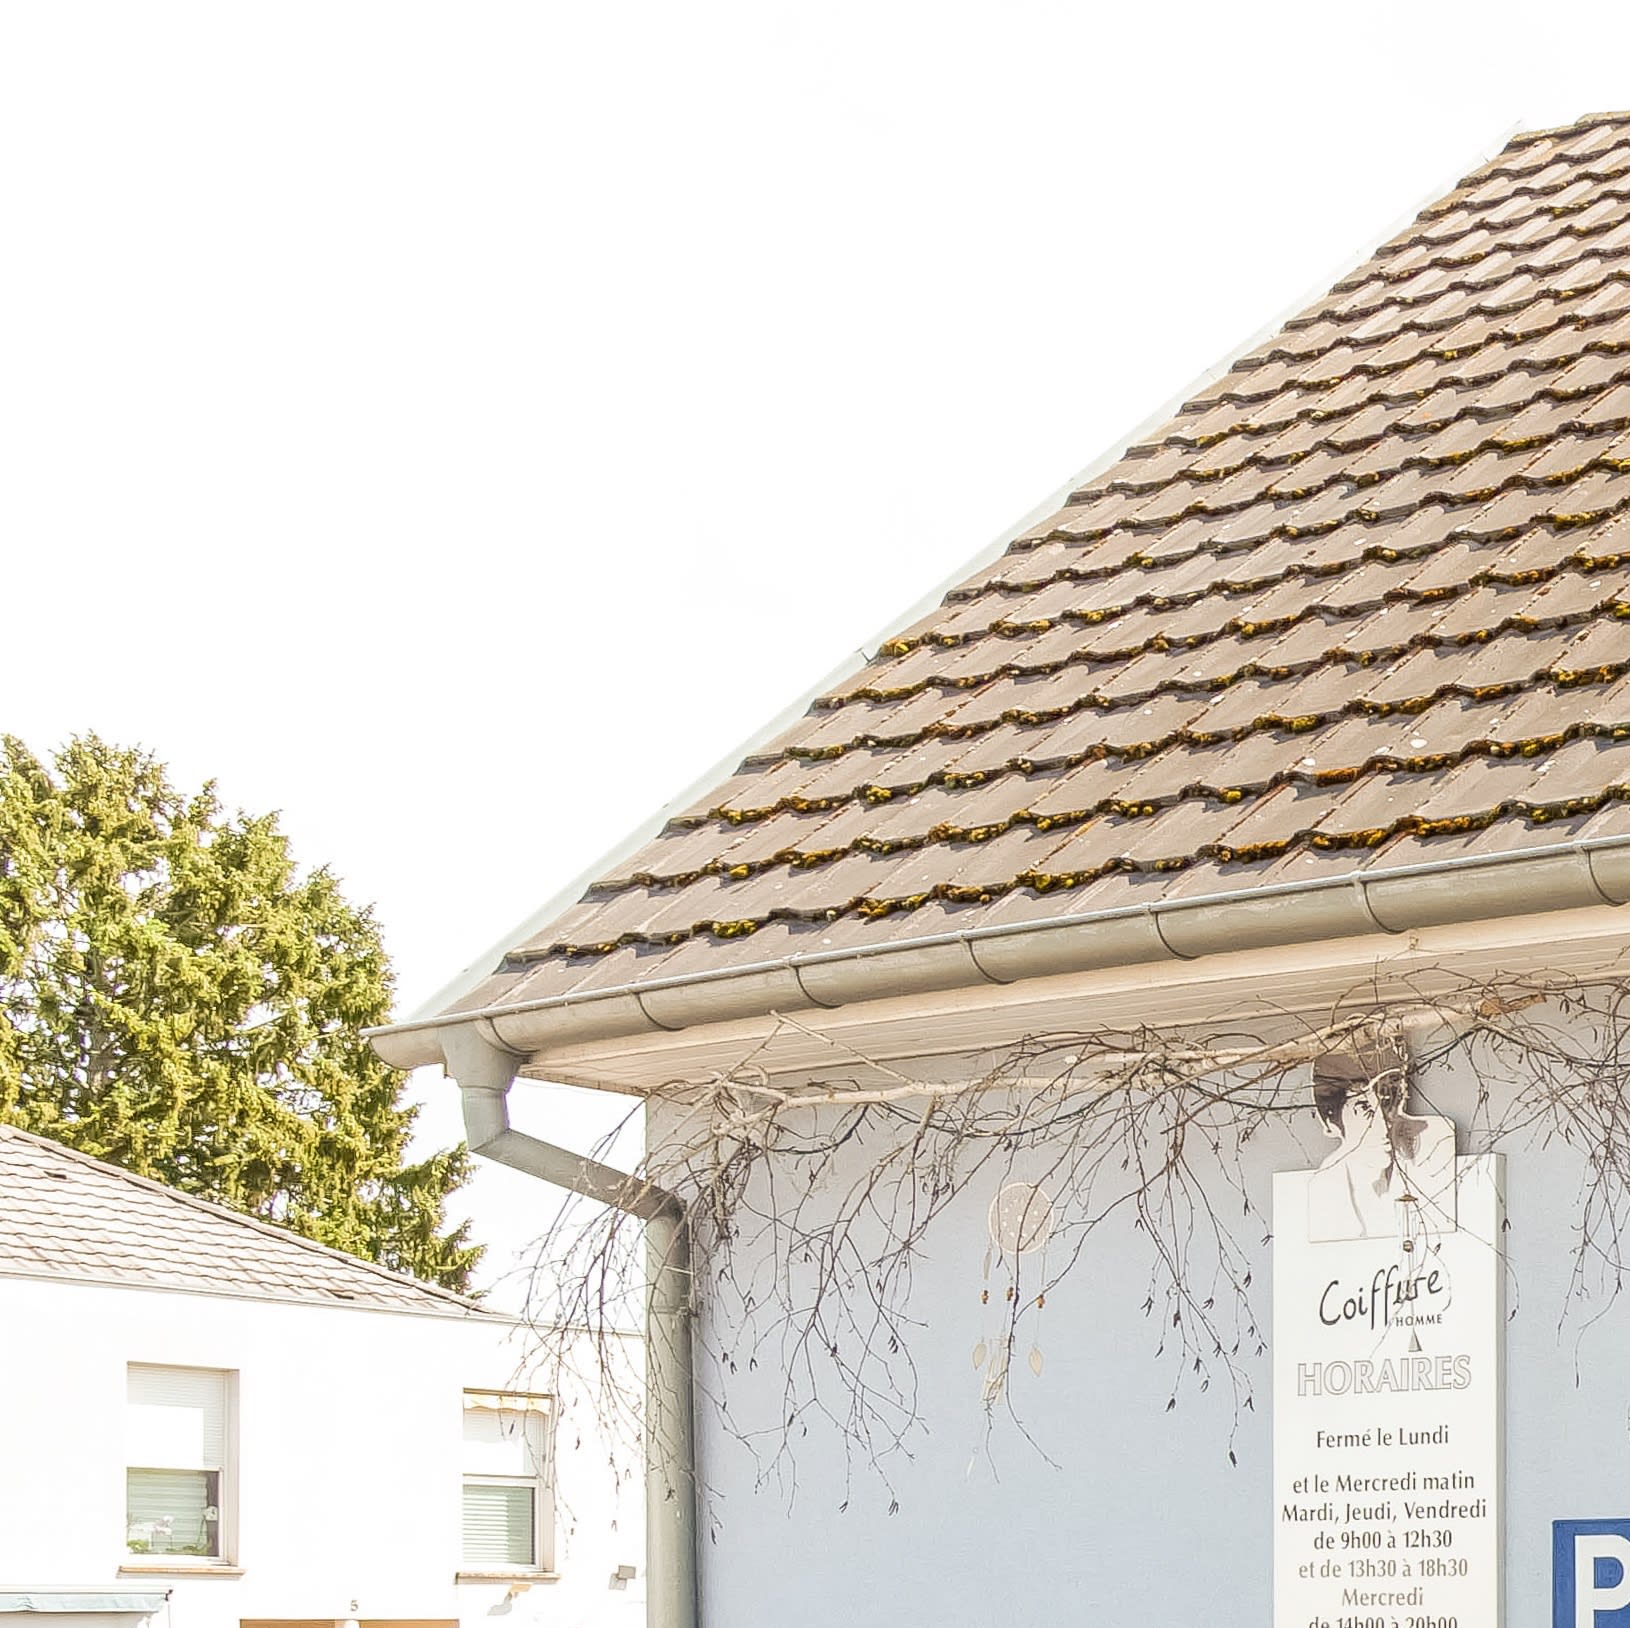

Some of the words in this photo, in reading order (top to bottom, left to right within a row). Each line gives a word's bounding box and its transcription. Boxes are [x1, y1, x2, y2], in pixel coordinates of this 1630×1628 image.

[1319, 1264, 1444, 1331] Coiffure
[1395, 1314, 1443, 1327] HOMME
[1297, 1355, 1472, 1397] HORAIRES
[1316, 1429, 1371, 1449] Fermé
[1378, 1428, 1392, 1446] le
[1399, 1426, 1449, 1445] Lundi
[1292, 1475, 1309, 1493] et
[1315, 1474, 1329, 1492] le
[1335, 1472, 1417, 1492] Mercredi
[1423, 1471, 1474, 1491] matin
[1282, 1503, 1339, 1524] Mardi,
[1344, 1501, 1397, 1524] Jeudi,
[1404, 1499, 1487, 1519] Vendredi
[1314, 1531, 1335, 1549] de
[1341, 1530, 1382, 1549] 9h00
[1387, 1530, 1396, 1548] à
[1404, 1529, 1452, 1548] 12h30
[1299, 1561, 1317, 1579] et
[1321, 1560, 1342, 1578] de
[1348, 1559, 1396, 1578] 13h30
[1402, 1559, 1412, 1577] à
[1419, 1558, 1468, 1577] 18h30
[351, 1600, 358, 1611] 5
[1342, 1588, 1424, 1607] Mercredi
